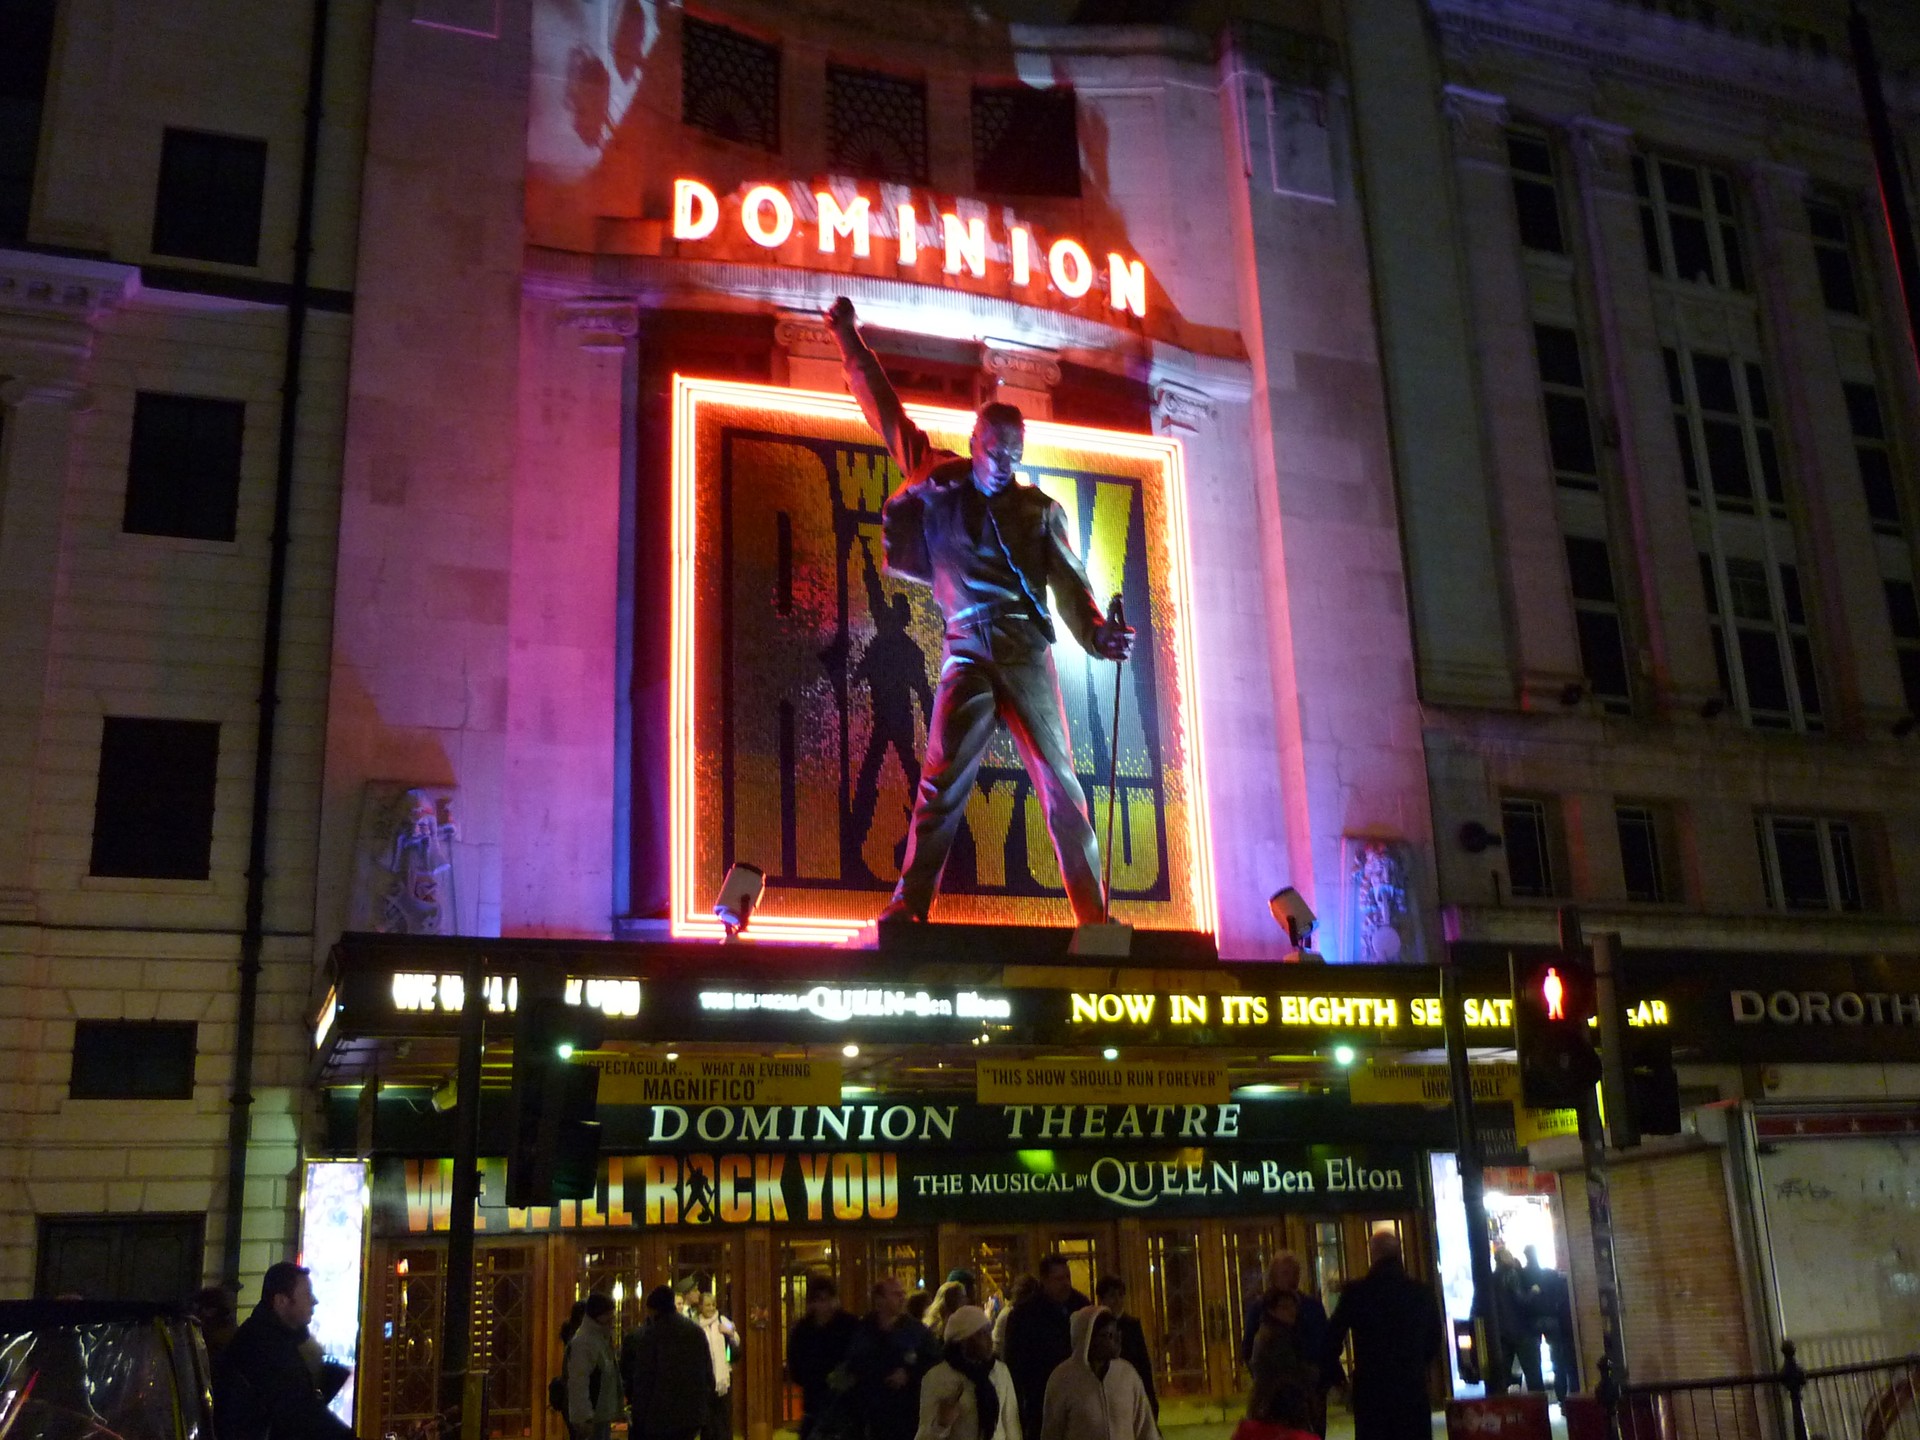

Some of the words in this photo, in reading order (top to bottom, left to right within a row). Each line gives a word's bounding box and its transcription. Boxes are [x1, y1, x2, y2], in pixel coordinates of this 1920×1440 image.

[673, 178, 1146, 318] DOMINION
[1071, 992, 1155, 1024] NOW
[1170, 994, 1208, 1024] IN
[1222, 995, 1269, 1025] ITS
[1281, 996, 1397, 1027] EIGHTH
[702, 1062, 736, 1077] WHAT
[740, 1063, 755, 1077] AN
[760, 1063, 811, 1078] EVENING
[1026, 1069, 1066, 1086] SHOW
[1070, 1070, 1122, 1086] SHOULD
[1127, 1070, 1154, 1087] RUN
[1158, 1070, 1223, 1087] FOREVER"
[1427, 1065, 1450, 1079] ABOU
[643, 1078, 764, 1101] MAGNIFICO"
[647, 1104, 958, 1143] DOMINION
[1003, 1102, 1242, 1139] THEATRE
[645, 1153, 790, 1226] ROCK
[798, 1152, 899, 1221] YOU
[913, 1174, 963, 1196] THE
[970, 1172, 1074, 1195] MUSICAL
[1075, 1173, 1088, 1188] BY
[1090, 1156, 1240, 1208] QUEEN
[1242, 1169, 1260, 1186] AND
[1261, 1160, 1315, 1195] Ben
[1325, 1156, 1404, 1194] Elton
